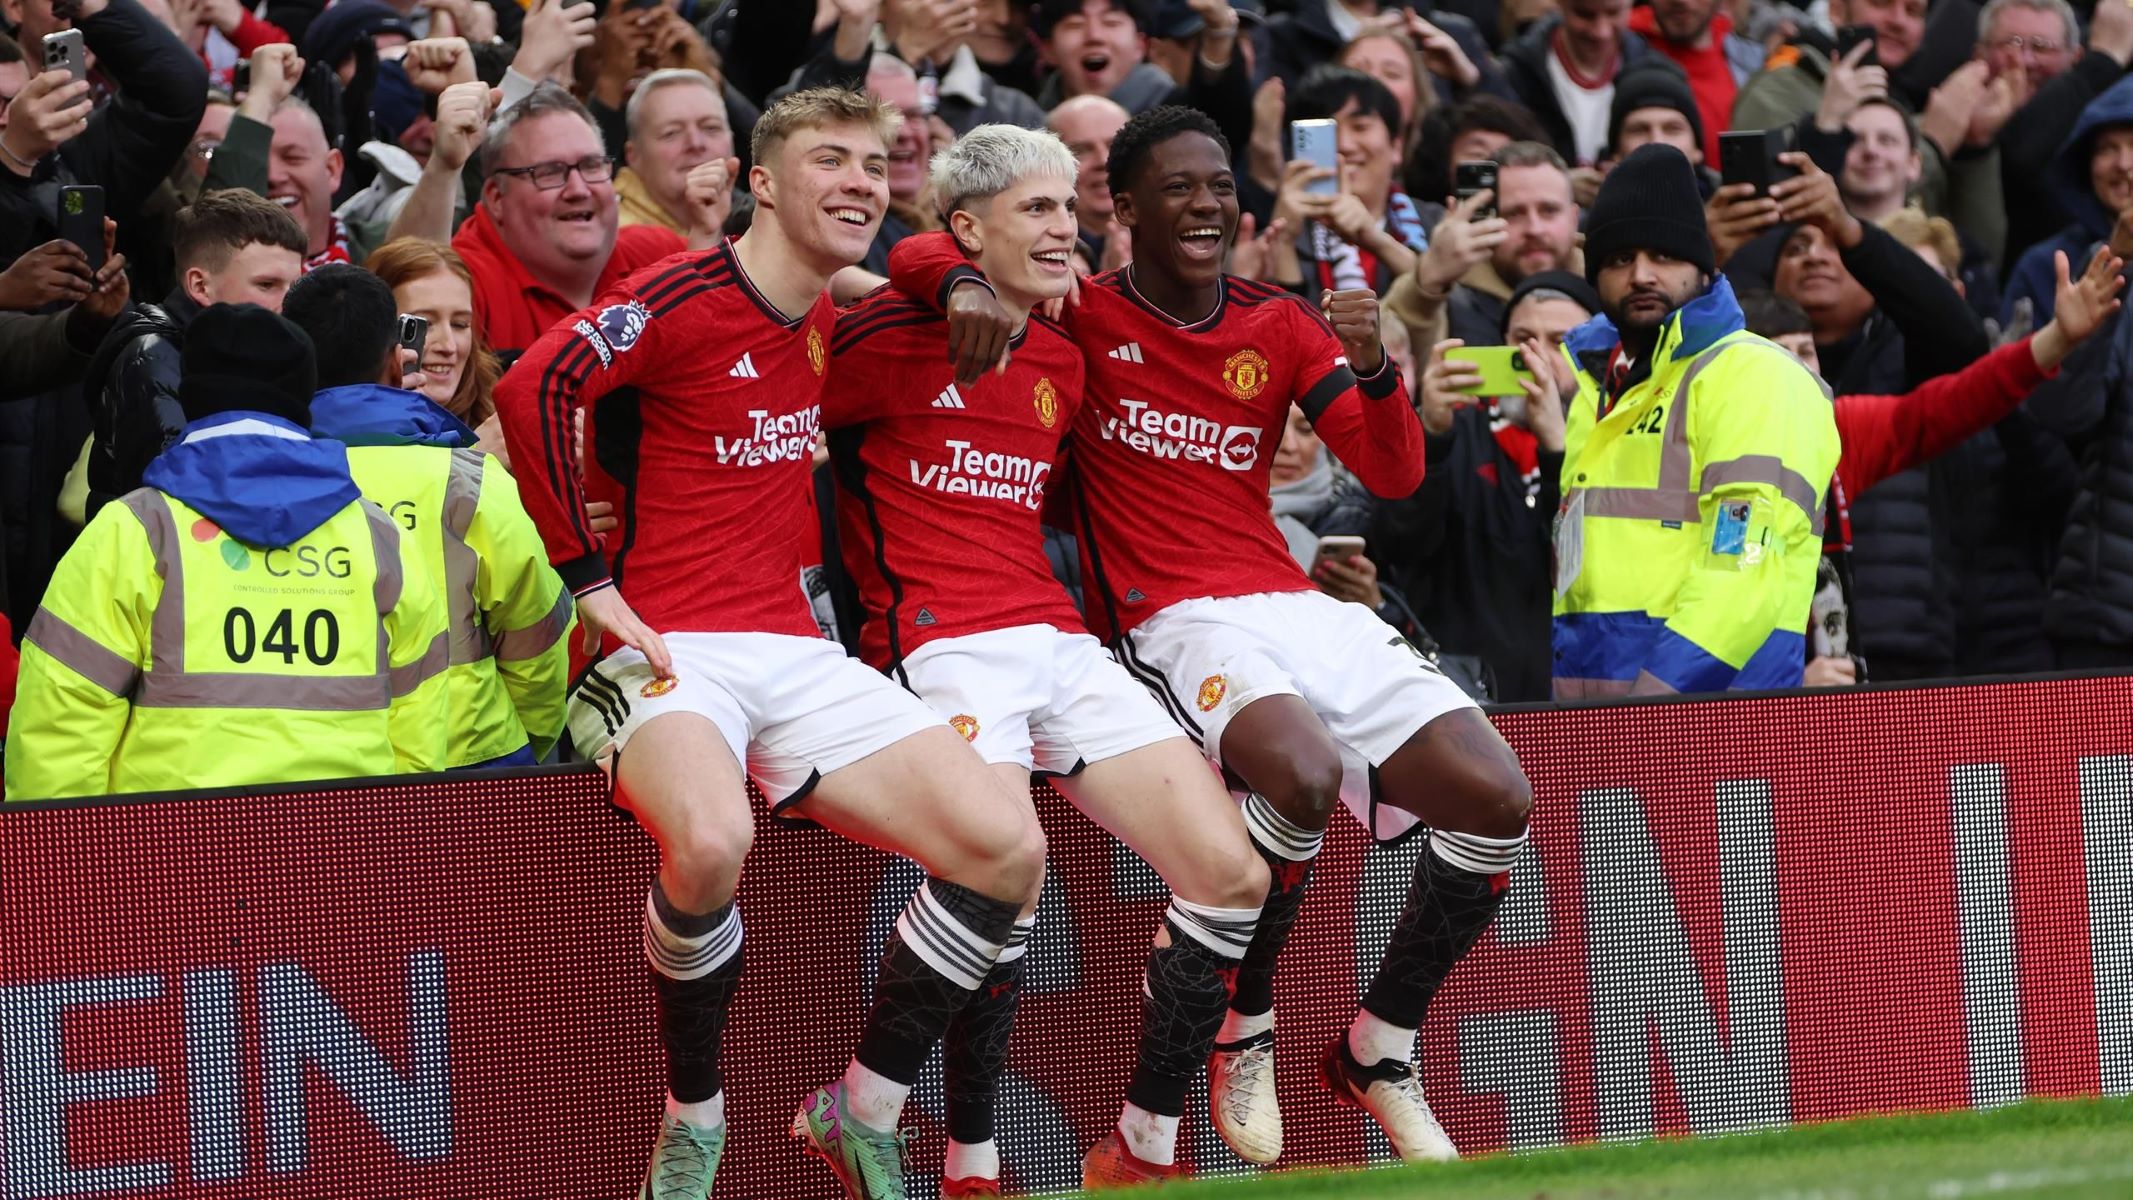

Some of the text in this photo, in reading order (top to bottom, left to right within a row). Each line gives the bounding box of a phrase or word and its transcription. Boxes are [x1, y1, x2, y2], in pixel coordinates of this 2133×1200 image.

[748, 407, 811, 442] Team
[1095, 409, 1217, 464] Viewer
[1119, 398, 1220, 444] Team
[715, 434, 808, 467] Viewer
[946, 439, 1031, 483] Team
[910, 459, 1026, 503] Viewer
[265, 546, 351, 578] CSG
[233, 584, 356, 596] CONTROLLED SOLUTIONS GROUP
[223, 606, 340, 666] 040
[0, 950, 455, 1198] EIN
